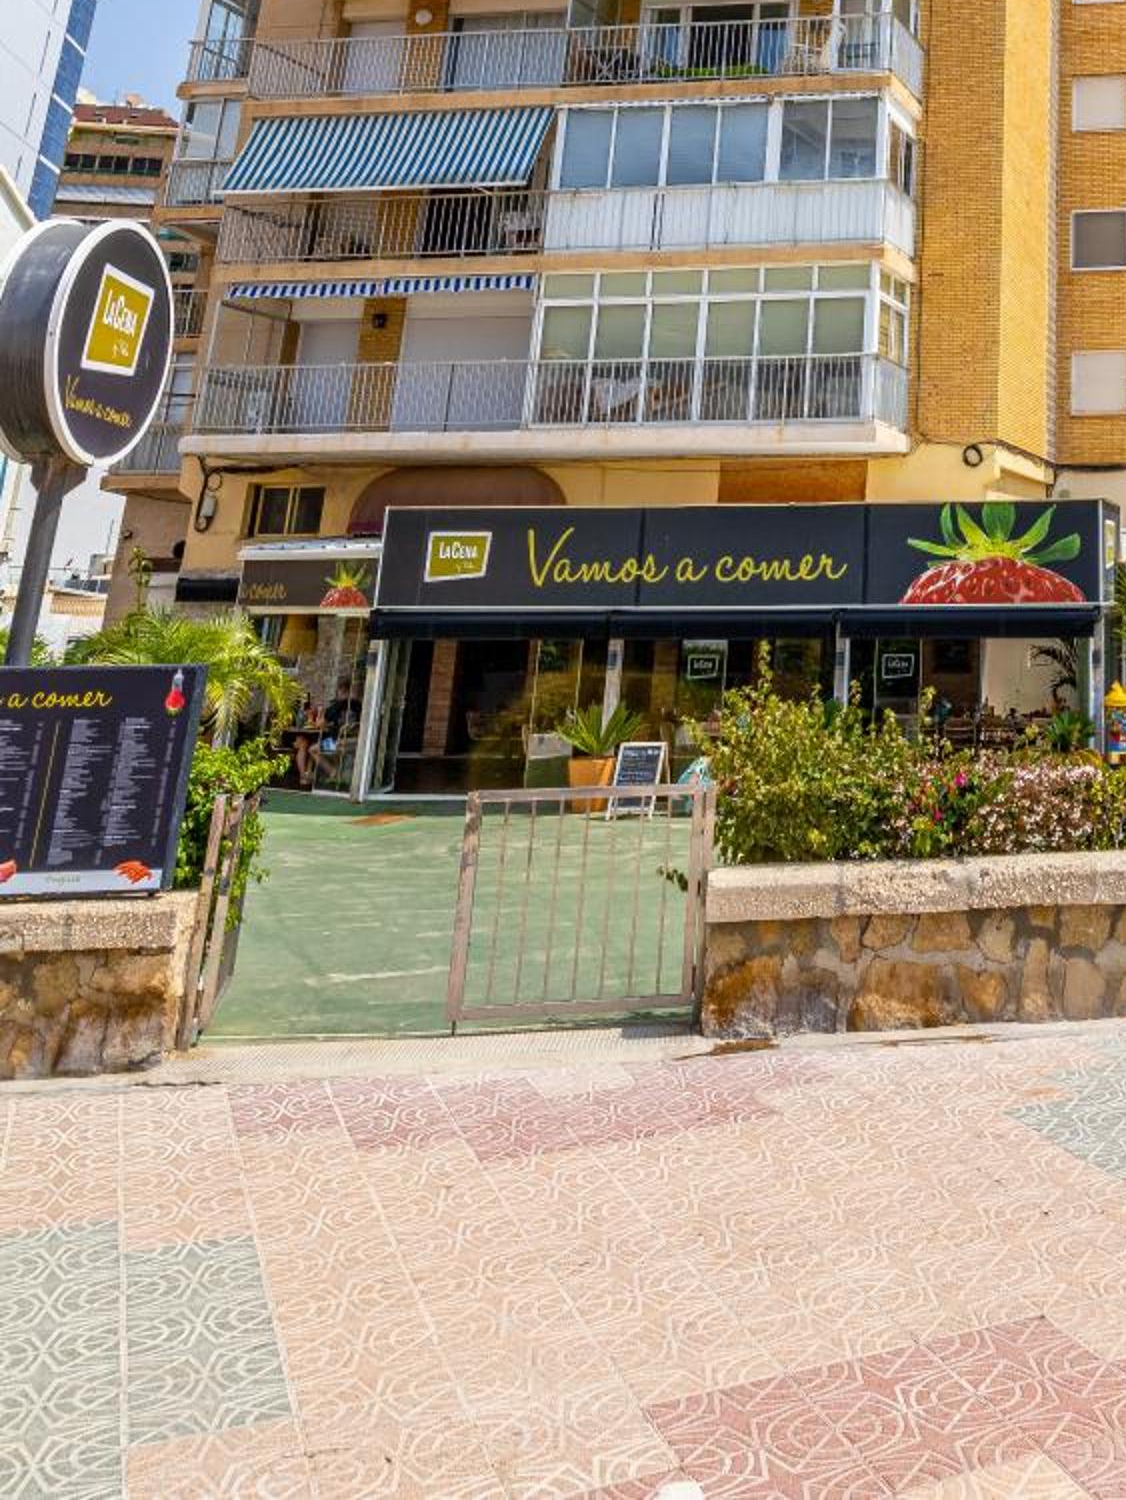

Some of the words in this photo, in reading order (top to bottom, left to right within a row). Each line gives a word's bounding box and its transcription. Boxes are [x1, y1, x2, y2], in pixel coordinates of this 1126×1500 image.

[527, 526, 669, 588] Vamos
[675, 556, 708, 582] a
[714, 553, 848, 581] comer
[8, 692, 28, 708] a
[31, 691, 113, 708] comer
